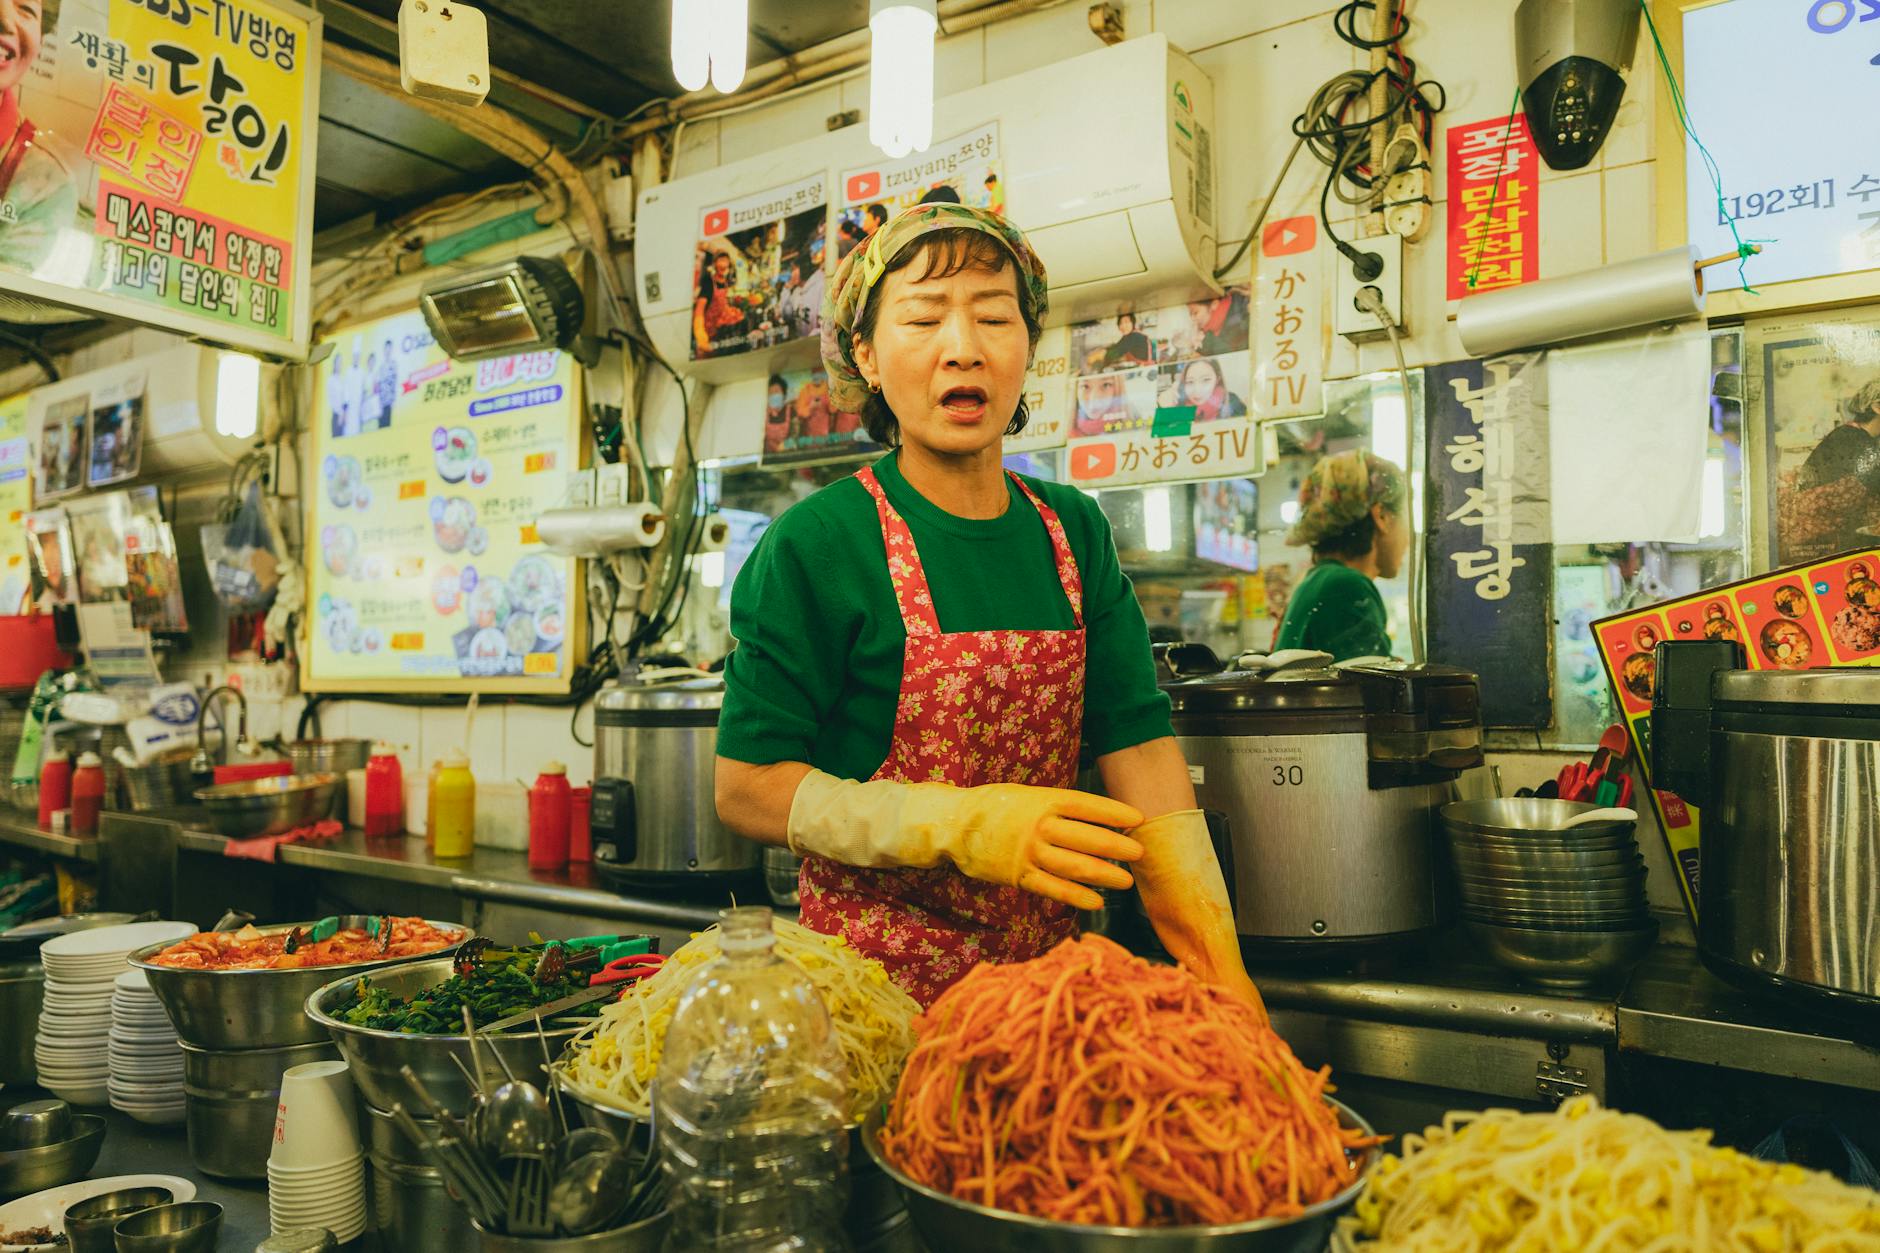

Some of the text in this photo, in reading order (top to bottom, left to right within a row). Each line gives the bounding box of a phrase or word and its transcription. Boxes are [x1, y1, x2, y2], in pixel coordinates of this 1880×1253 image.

[151, 44, 288, 184] 달인
[886, 133, 993, 189] tzuyang쯔양
[733, 184, 823, 226] tzuyang쯔양
[1457, 122, 1529, 290] 포장 만삼천원
[1718, 178, 1835, 226] [192회]
[225, 231, 282, 286] 인정한
[179, 260, 241, 317] 달인의
[1267, 268, 1307, 407] かおるTV
[1120, 427, 1250, 472] かおるTV
[1445, 362, 1527, 601] 남해식당
[1272, 765, 1303, 786] 30
